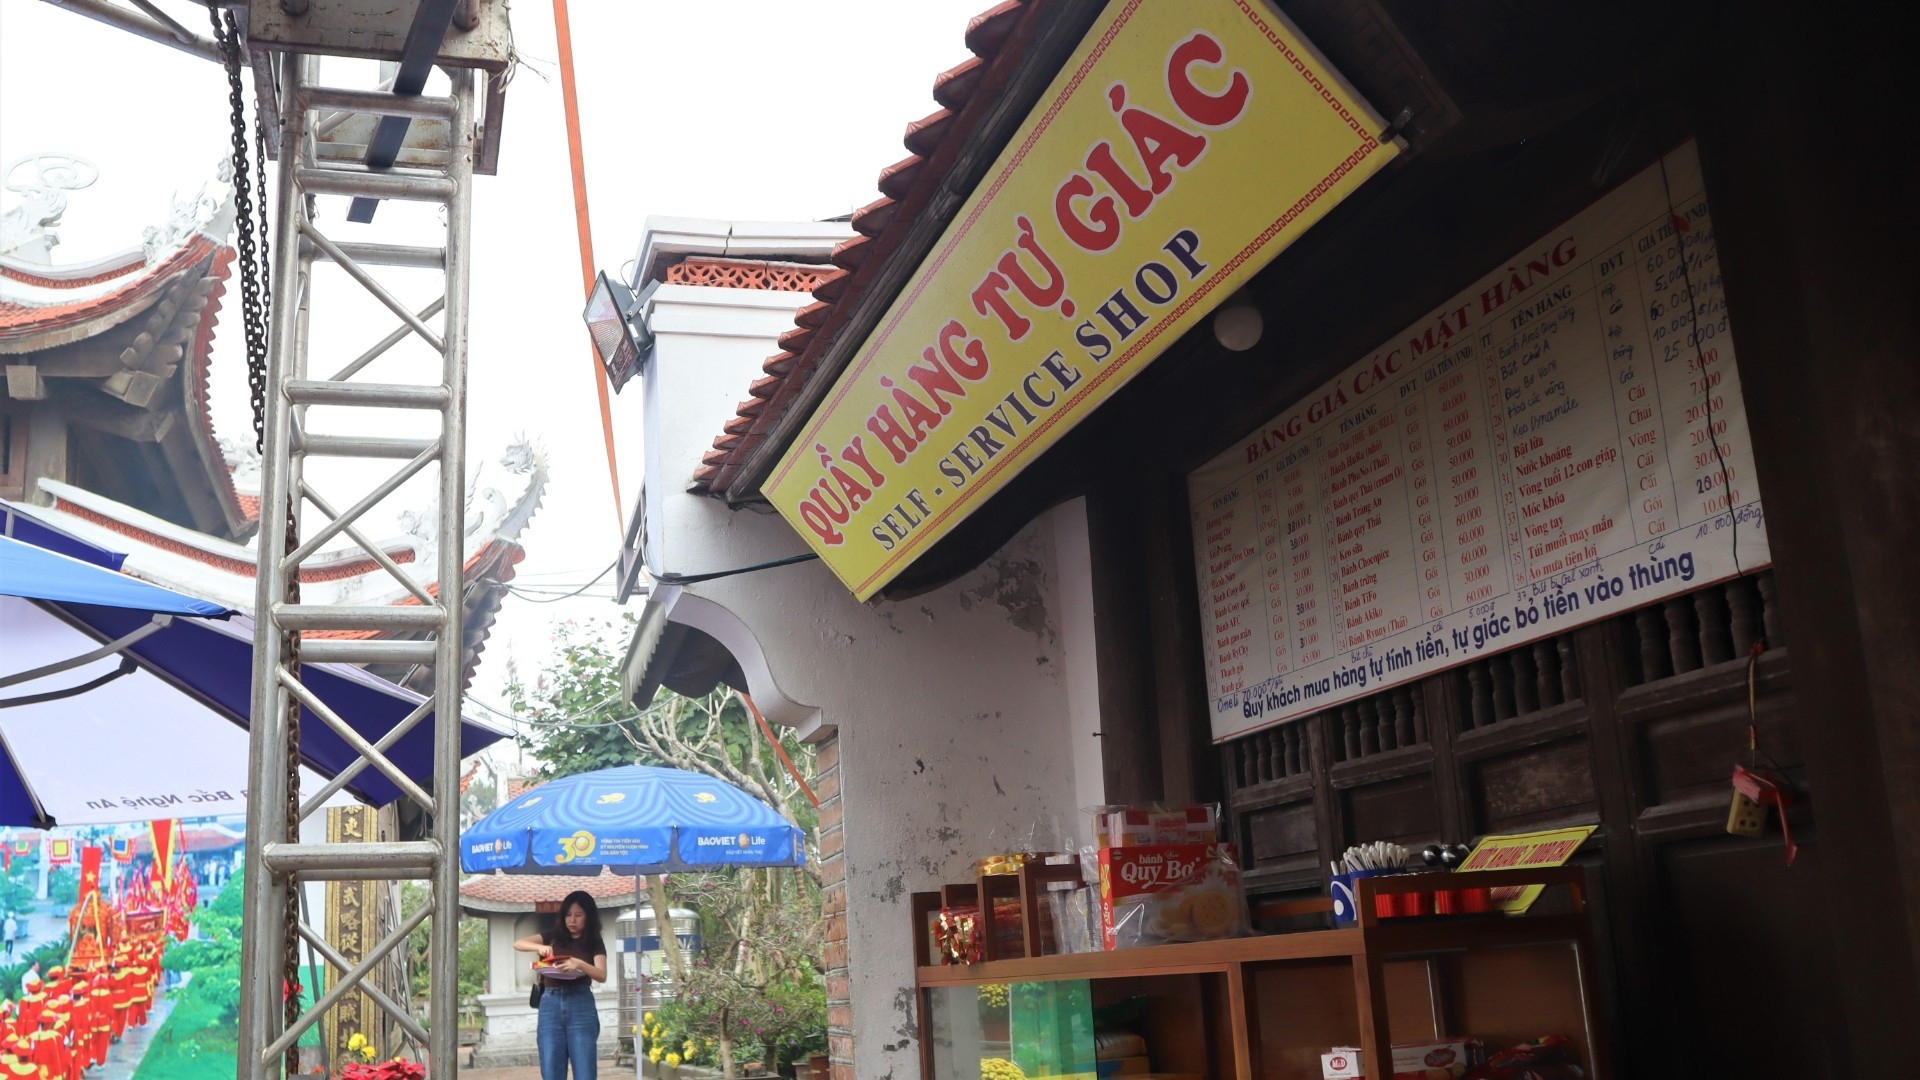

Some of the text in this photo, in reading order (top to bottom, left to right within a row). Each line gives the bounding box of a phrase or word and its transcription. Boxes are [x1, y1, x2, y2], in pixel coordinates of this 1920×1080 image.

[798, 28, 1253, 547] QUẦY HÀNG TỰ GIÁC
[1510, 309, 1534, 330] TÊN
[1536, 284, 1572, 315] HÀNG
[1600, 252, 1624, 276] ĐVT
[1638, 228, 1656, 253] GIÁ
[1246, 414, 1303, 465] BẢNG
[1307, 379, 1348, 424] GIÁ
[1353, 349, 1403, 395] CÁC
[1409, 303, 1471, 362] MẶT
[1480, 236, 1577, 316] HÀNG
[869, 488, 933, 551] SELF
[937, 350, 1082, 488] SERVICE
[1075, 228, 1208, 362] SHOP
[1400, 379, 1416, 398] ĐVT
[1499, 452, 1508, 466] 30
[1514, 443, 1529, 460] Bật
[1628, 384, 1646, 402] Cái
[1502, 472, 1510, 486] 31
[1516, 458, 1539, 480] Nước
[1540, 445, 1573, 469] khoáng
[1628, 403, 1652, 425] Chai
[1504, 395, 1724, 506] 32 Vòng tuổi 12 con giáp Vòng 20.000
[1414, 474, 1427, 490] Gói
[1416, 492, 1429, 508] Gói
[1451, 466, 1477, 489] 50.000
[1507, 419, 1727, 526] 33 Móc khóa Cái 20.000
[1510, 531, 1519, 546] 34
[1524, 521, 1549, 540] Vòng
[1639, 473, 1658, 492] Cái
[1695, 443, 1732, 470] 30.000
[1419, 511, 1431, 526] Gói
[1454, 486, 1479, 508] 20.000
[1421, 529, 1434, 544] Gói
[1456, 505, 1482, 527] 60.000
[1513, 552, 1521, 566] 35
[1528, 539, 1544, 560] Túi
[1545, 530, 1568, 552] muối
[1592, 513, 1614, 535] mắn
[1643, 498, 1664, 517] Gói
[1423, 547, 1436, 562] Gói
[1458, 524, 1485, 546] 60.000
[1425, 566, 1439, 581] Gói
[1461, 543, 1487, 565] 60.000
[1516, 490, 1740, 586] 36 Áo mưa tiện lợi Cái 10.000
[1427, 585, 1441, 600] Gói
[1464, 564, 1490, 585] 30.000
[1430, 604, 1444, 619] Gói
[1466, 584, 1493, 603] 60.000
[1266, 685, 1301, 712] khách
[1304, 677, 1331, 700] mua
[1333, 665, 1367, 688] hàng
[1369, 656, 1384, 682] tự
[1386, 644, 1412, 673] tính
[1416, 631, 1449, 658] tiền,
[1452, 626, 1469, 654] tự
[1473, 613, 1511, 650] giác
[1515, 597, 1539, 629] bỏ
[1544, 584, 1580, 619] tiền
[1585, 576, 1624, 606] vào
[1628, 551, 1695, 591] thùng
[697, 836, 766, 846] BAOVIET Life
[1139, 854, 1163, 864] bánh
[1121, 861, 1162, 889] Quy
